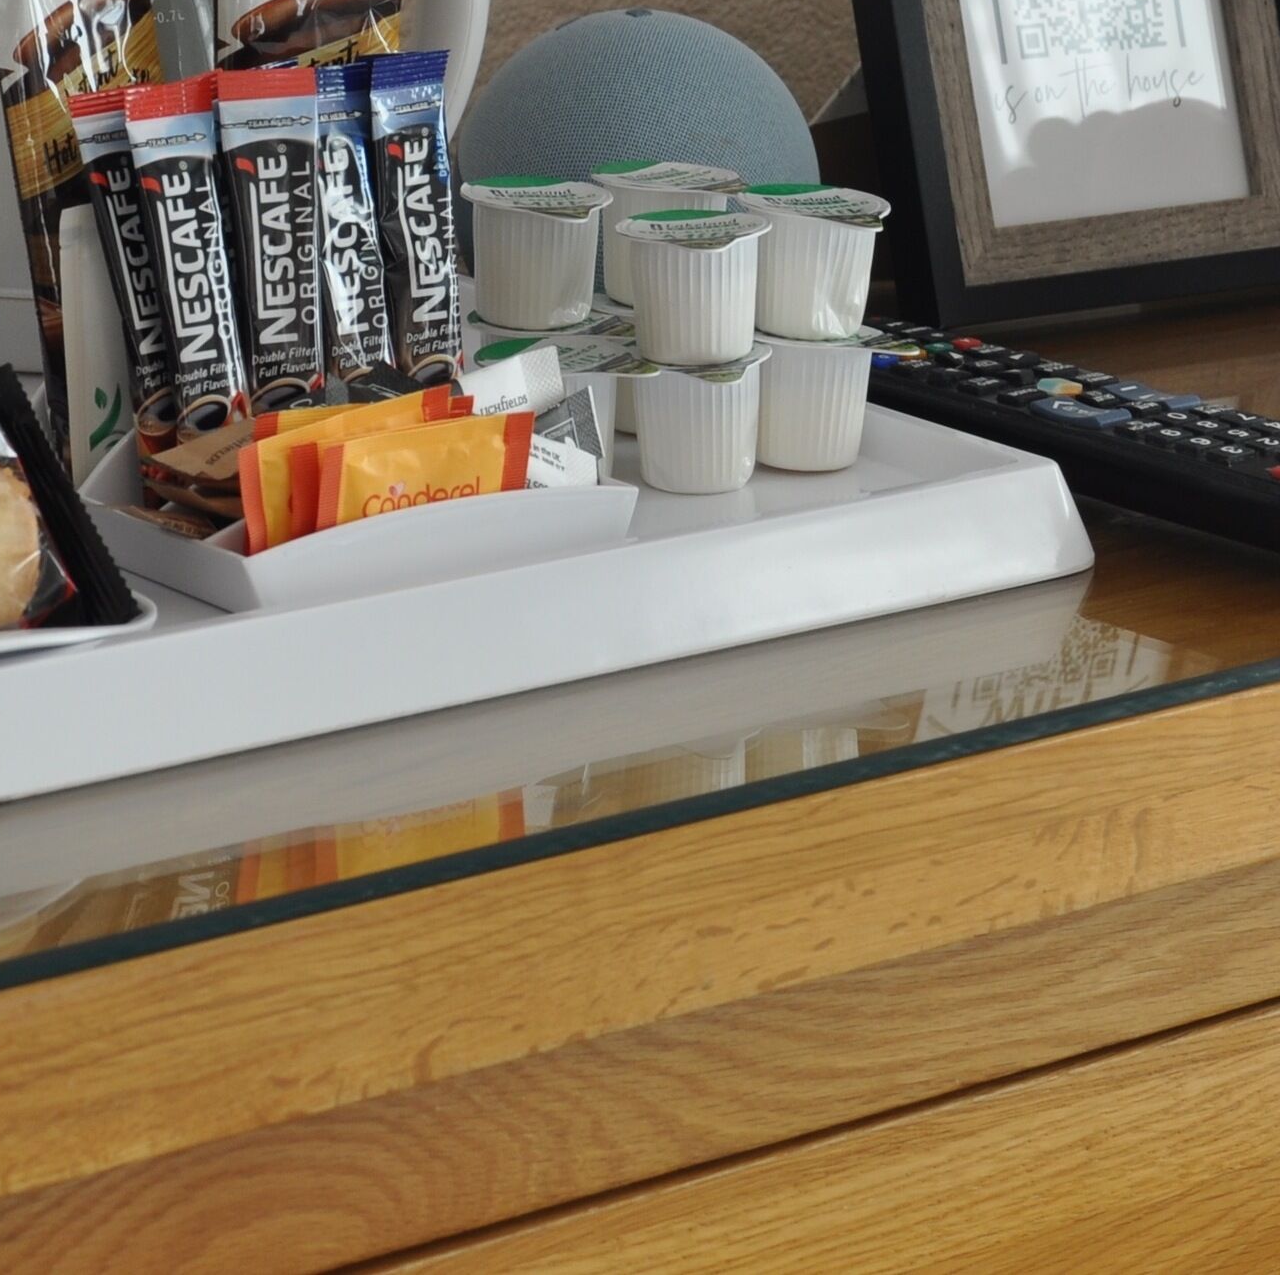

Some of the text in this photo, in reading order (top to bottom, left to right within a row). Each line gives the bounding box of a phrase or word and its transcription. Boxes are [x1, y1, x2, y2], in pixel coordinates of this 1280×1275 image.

[156, 9, 185, 23] 0.7L
[1034, 84, 1067, 104] on
[1126, 52, 1205, 108] house
[292, 161, 318, 325] ORIGINAL
[363, 335, 384, 349] Filte
[406, 328, 438, 344] Double
[413, 342, 431, 356] Full
[252, 347, 316, 366] Double Filter
[175, 367, 208, 385] Double
[210, 362, 235, 376] Filt
[259, 362, 317, 379] Full Flavour
[183, 378, 235, 399] Full Flavo
[1167, 412, 1188, 421] 0
[1237, 412, 1257, 422] 7
[1196, 420, 1218, 429] 8
[1160, 428, 1181, 437] 9
[1227, 428, 1249, 437] 5
[1190, 437, 1211, 446] 6
[1256, 437, 1279, 446] 2
[1221, 445, 1243, 454] 3
